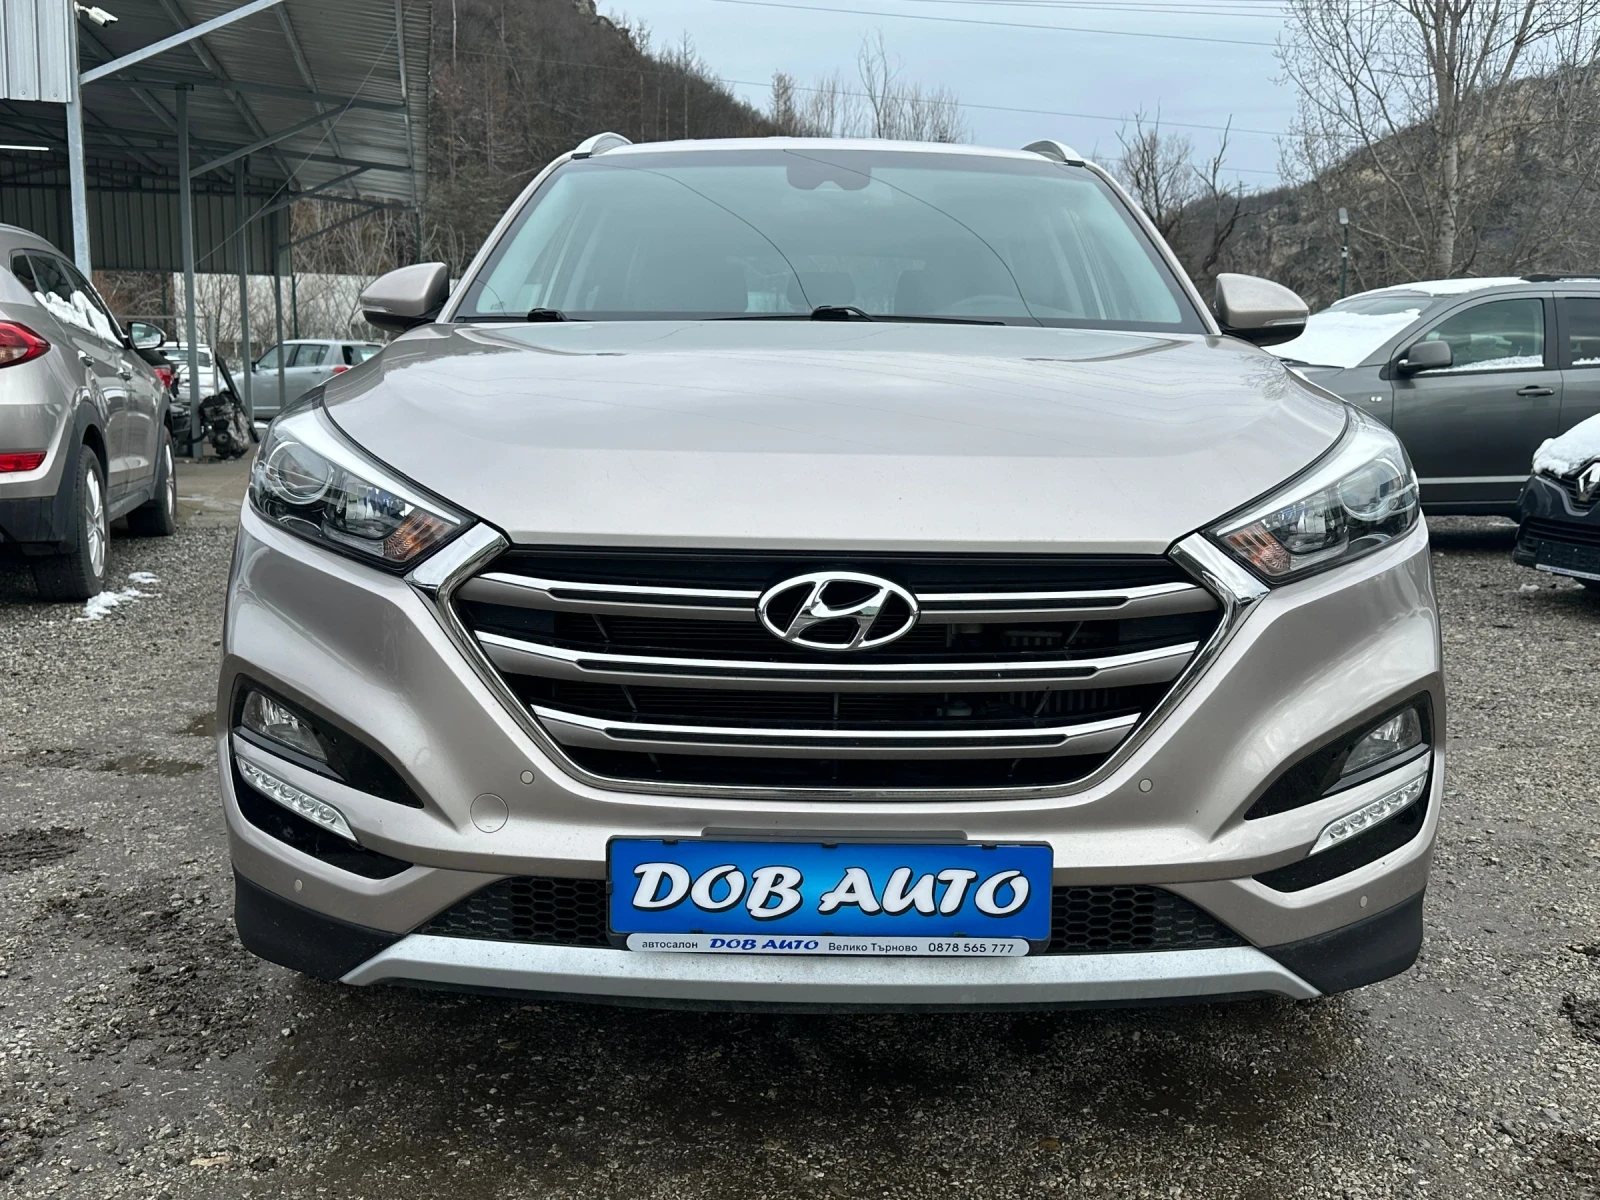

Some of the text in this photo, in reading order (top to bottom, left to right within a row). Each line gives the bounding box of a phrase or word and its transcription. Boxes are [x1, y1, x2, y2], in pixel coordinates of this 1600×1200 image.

[632, 861, 1031, 921] DOB AUTO
[641, 937, 1014, 954] автосалон DOB AUTO Велико Търново 0878 565 777
